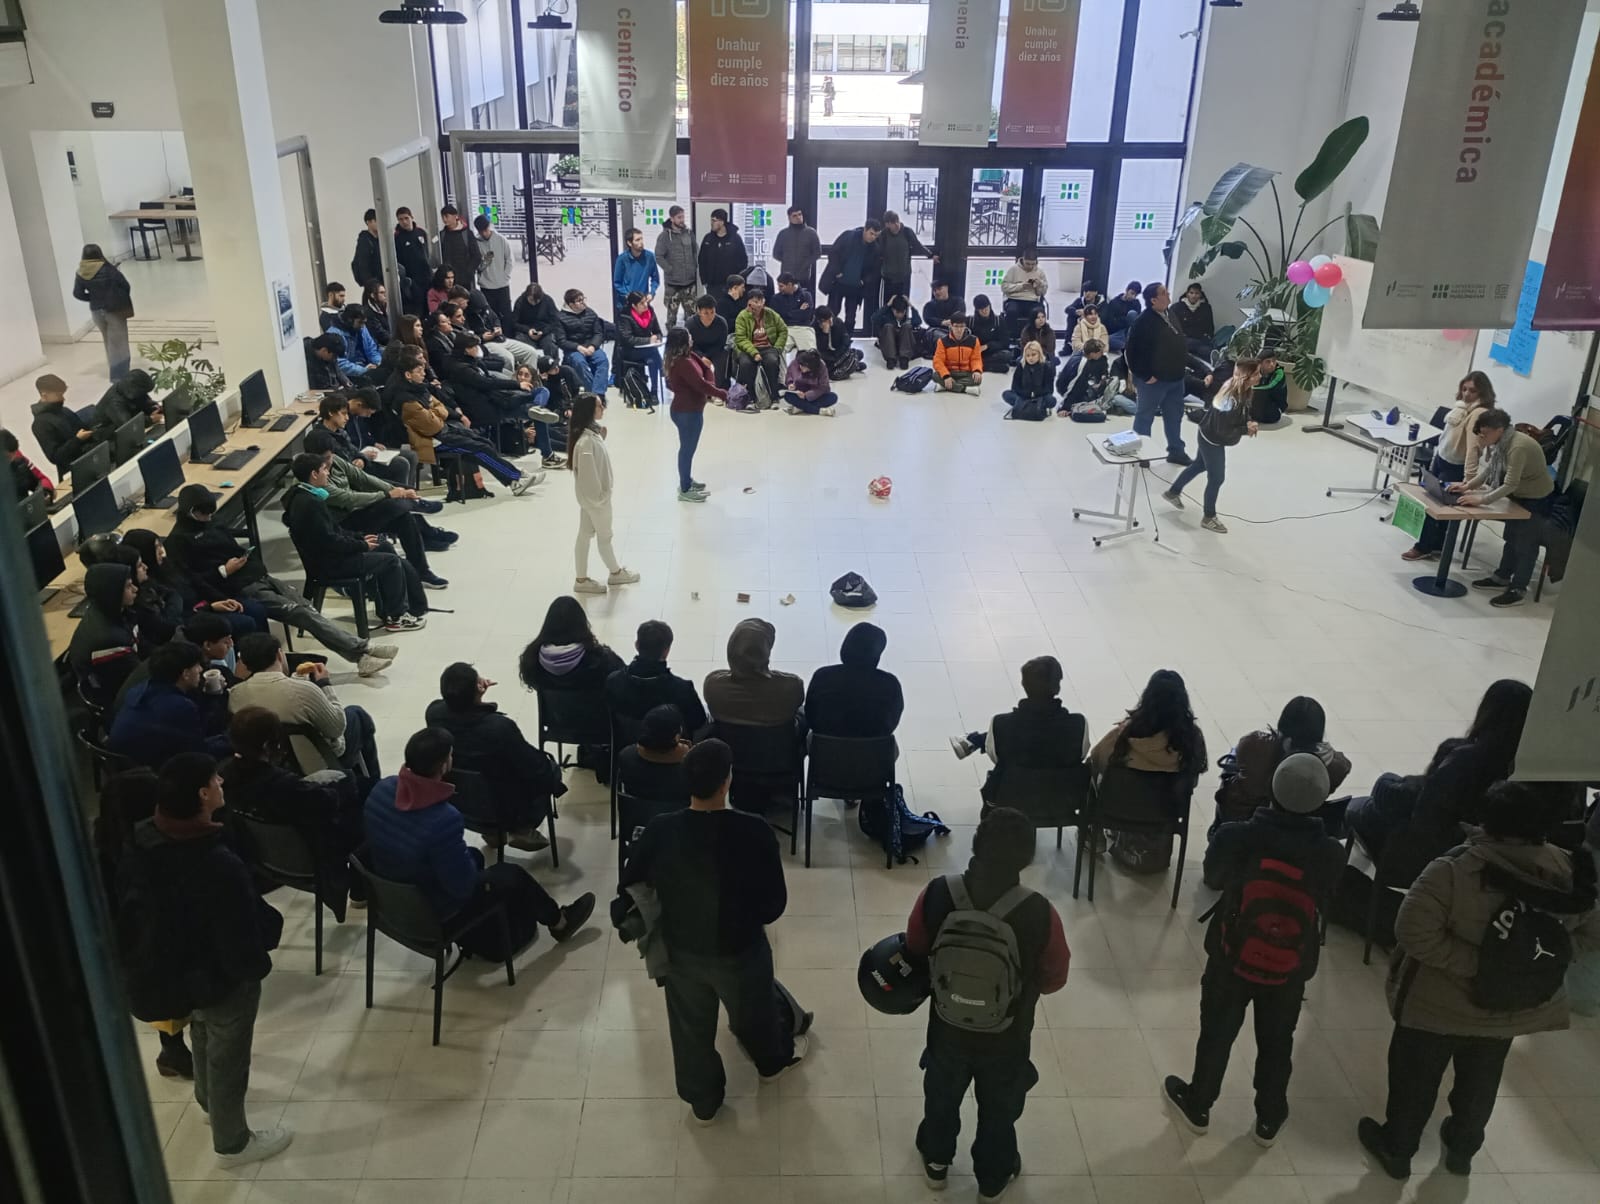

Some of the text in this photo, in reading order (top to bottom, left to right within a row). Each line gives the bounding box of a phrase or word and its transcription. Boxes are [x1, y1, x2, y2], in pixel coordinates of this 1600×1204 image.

[1025, 26, 1057, 36] Unahur
[716, 37, 761, 51] Unahur
[1024, 39, 1058, 50] cumple
[617, 7, 637, 113] científico
[1018, 52, 1061, 62] diez años
[717, 56, 763, 73] cumple
[710, 73, 769, 87] diez años
[1455, 0, 1509, 183] académica
[1492, 906, 1518, 940] JO
